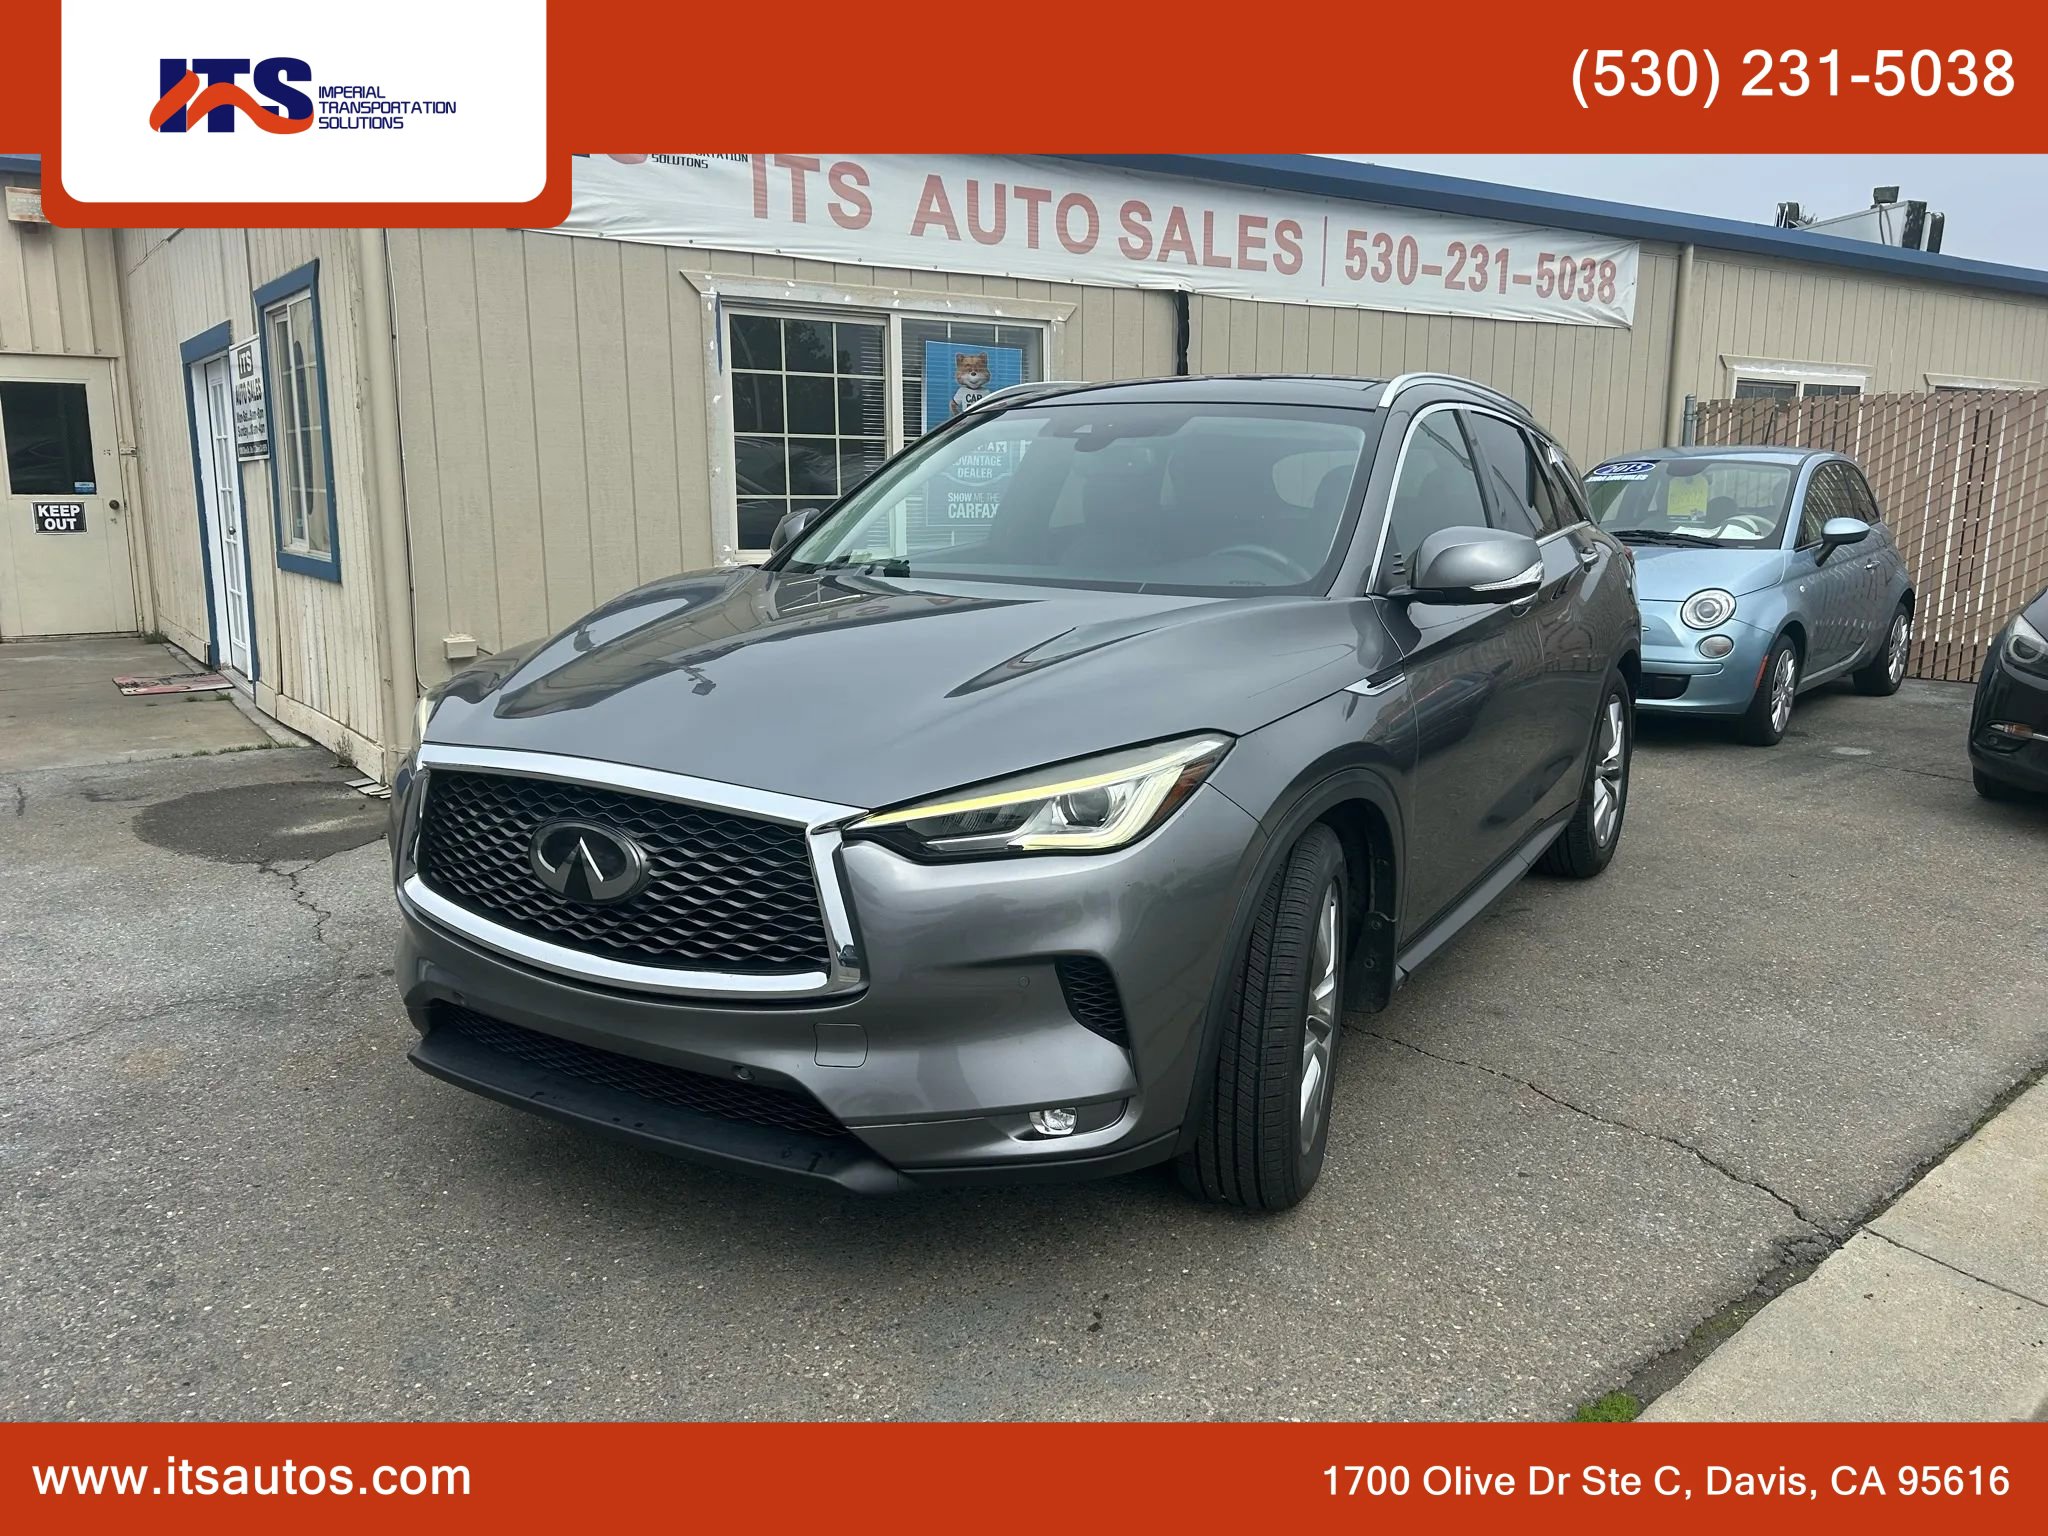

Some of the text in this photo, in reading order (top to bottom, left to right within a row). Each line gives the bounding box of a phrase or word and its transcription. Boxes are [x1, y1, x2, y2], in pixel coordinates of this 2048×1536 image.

[752, 154, 1617, 305] ITS AUTO SALES 530-231-5038
[239, 350, 252, 374] ITS
[957, 467, 993, 478] DEALER
[947, 492, 1001, 503] SHOW ME THE
[37, 505, 80, 517] KEEP
[947, 503, 1000, 519] CARFAX
[44, 518, 77, 530] OUT
